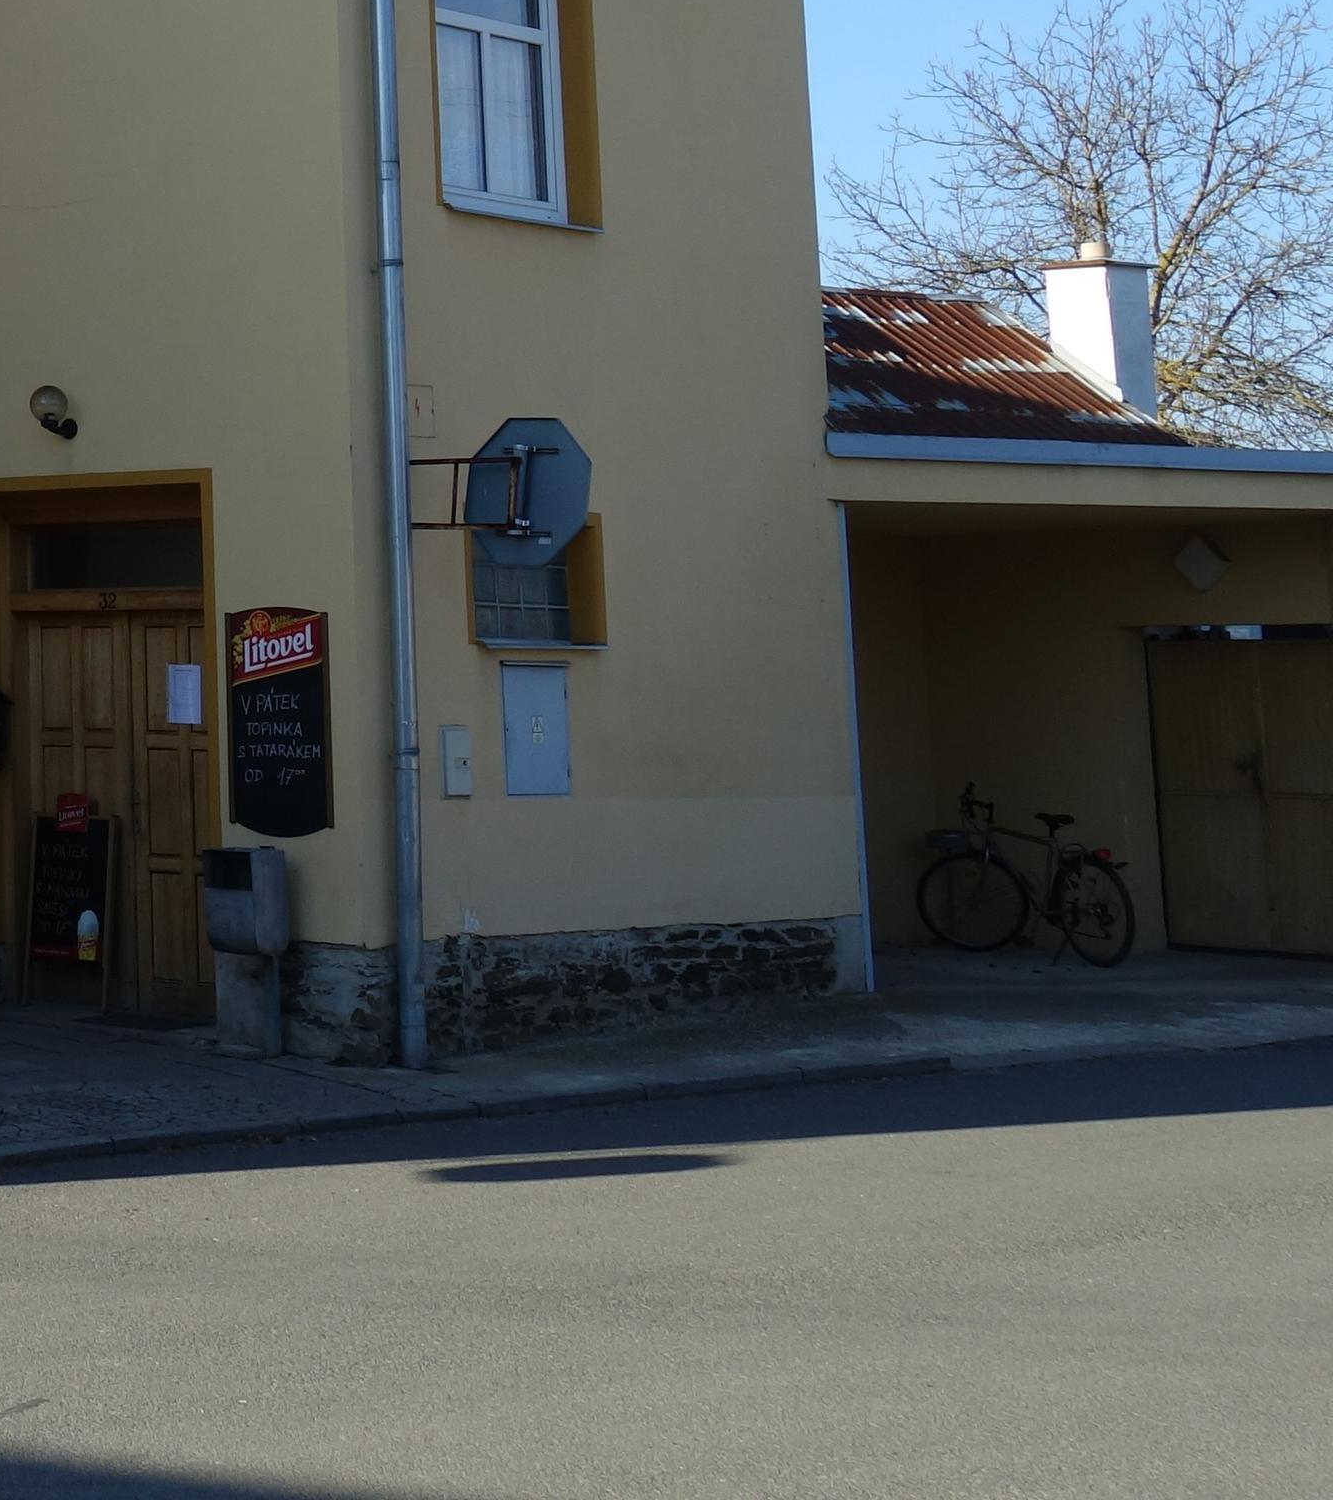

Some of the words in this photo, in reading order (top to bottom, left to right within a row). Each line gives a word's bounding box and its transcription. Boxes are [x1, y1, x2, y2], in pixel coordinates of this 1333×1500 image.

[97, 590, 117, 607] 32
[242, 622, 315, 674] Litovel
[240, 693, 251, 716] V
[256, 686, 301, 713] PÁTEK
[249, 739, 322, 759] TATARÁKEM
[244, 768, 263, 783] OD
